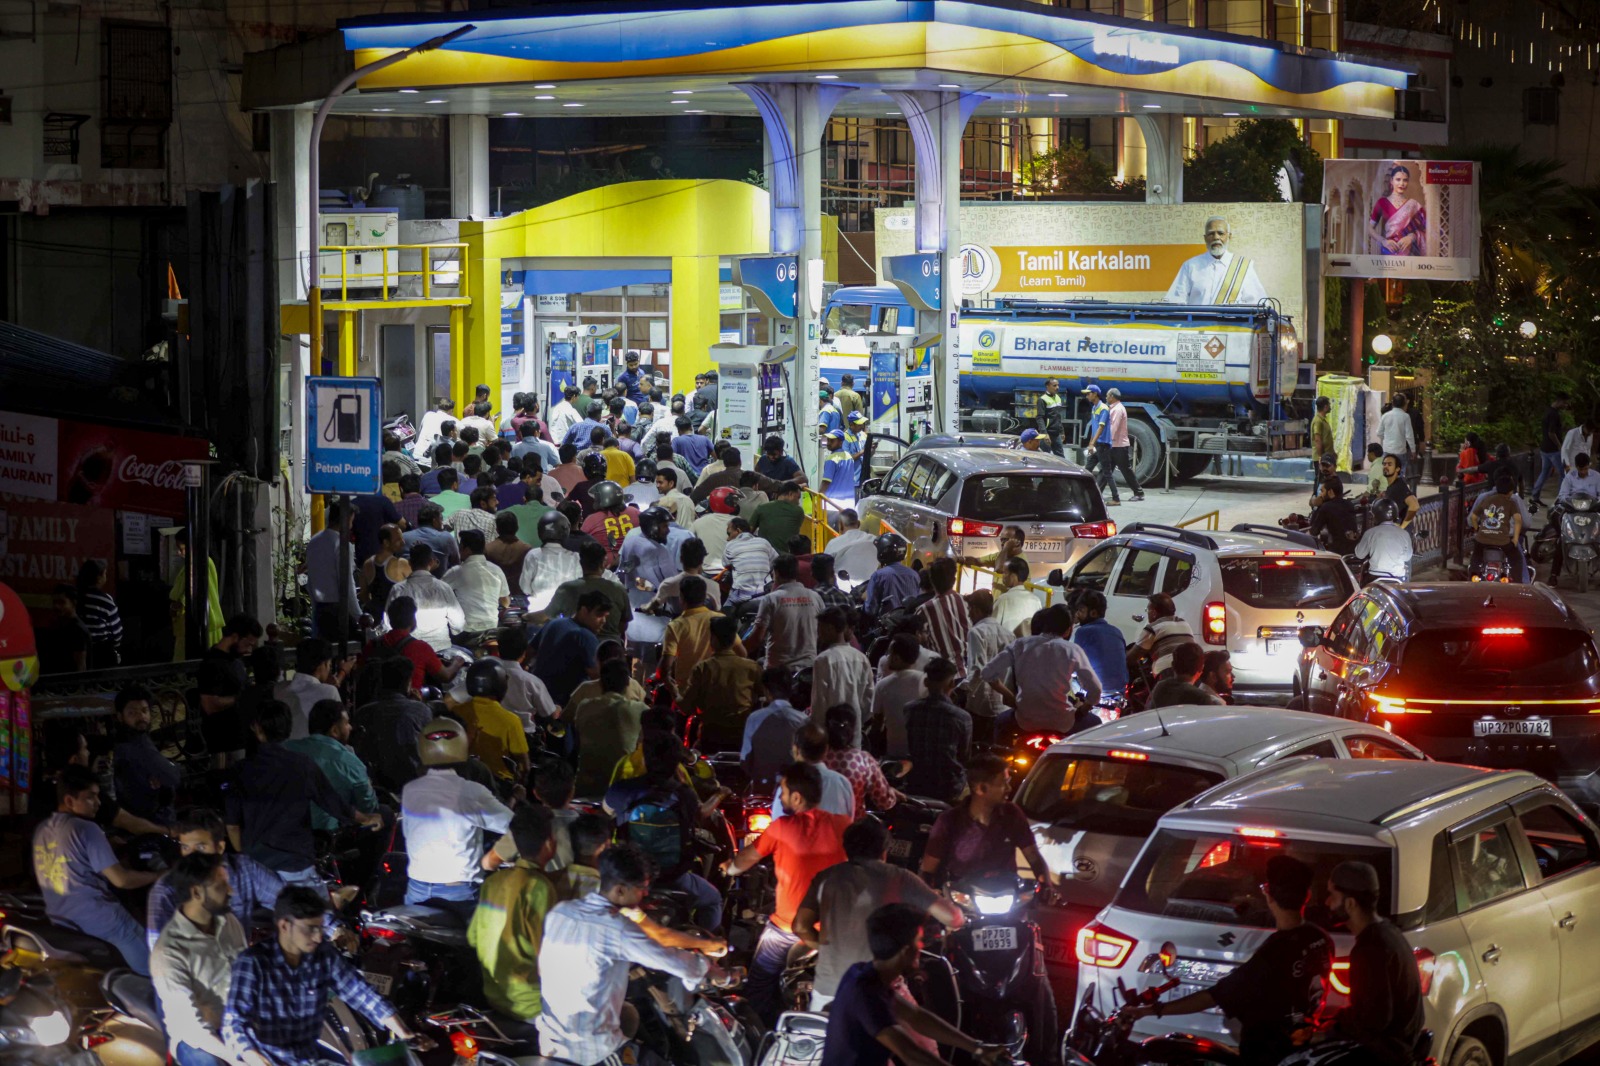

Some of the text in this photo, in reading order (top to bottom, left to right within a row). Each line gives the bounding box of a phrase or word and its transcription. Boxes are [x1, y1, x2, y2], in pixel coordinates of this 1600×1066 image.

[1017, 250, 1150, 271] Tamil Karkalam
[1020, 275, 1086, 288] (Learn Tamil)
[934, 288, 940, 300] 3
[1014, 337, 1166, 356] Bharat Petroleum
[0, 466, 54, 486] AURANT
[316, 462, 372, 478] Petrol Pump
[8, 515, 80, 543] FAMILY
[604, 514, 634, 539] 66
[1024, 541, 1061, 551] 78FS2777
[1480, 722, 1550, 734] UP32PQ8782
